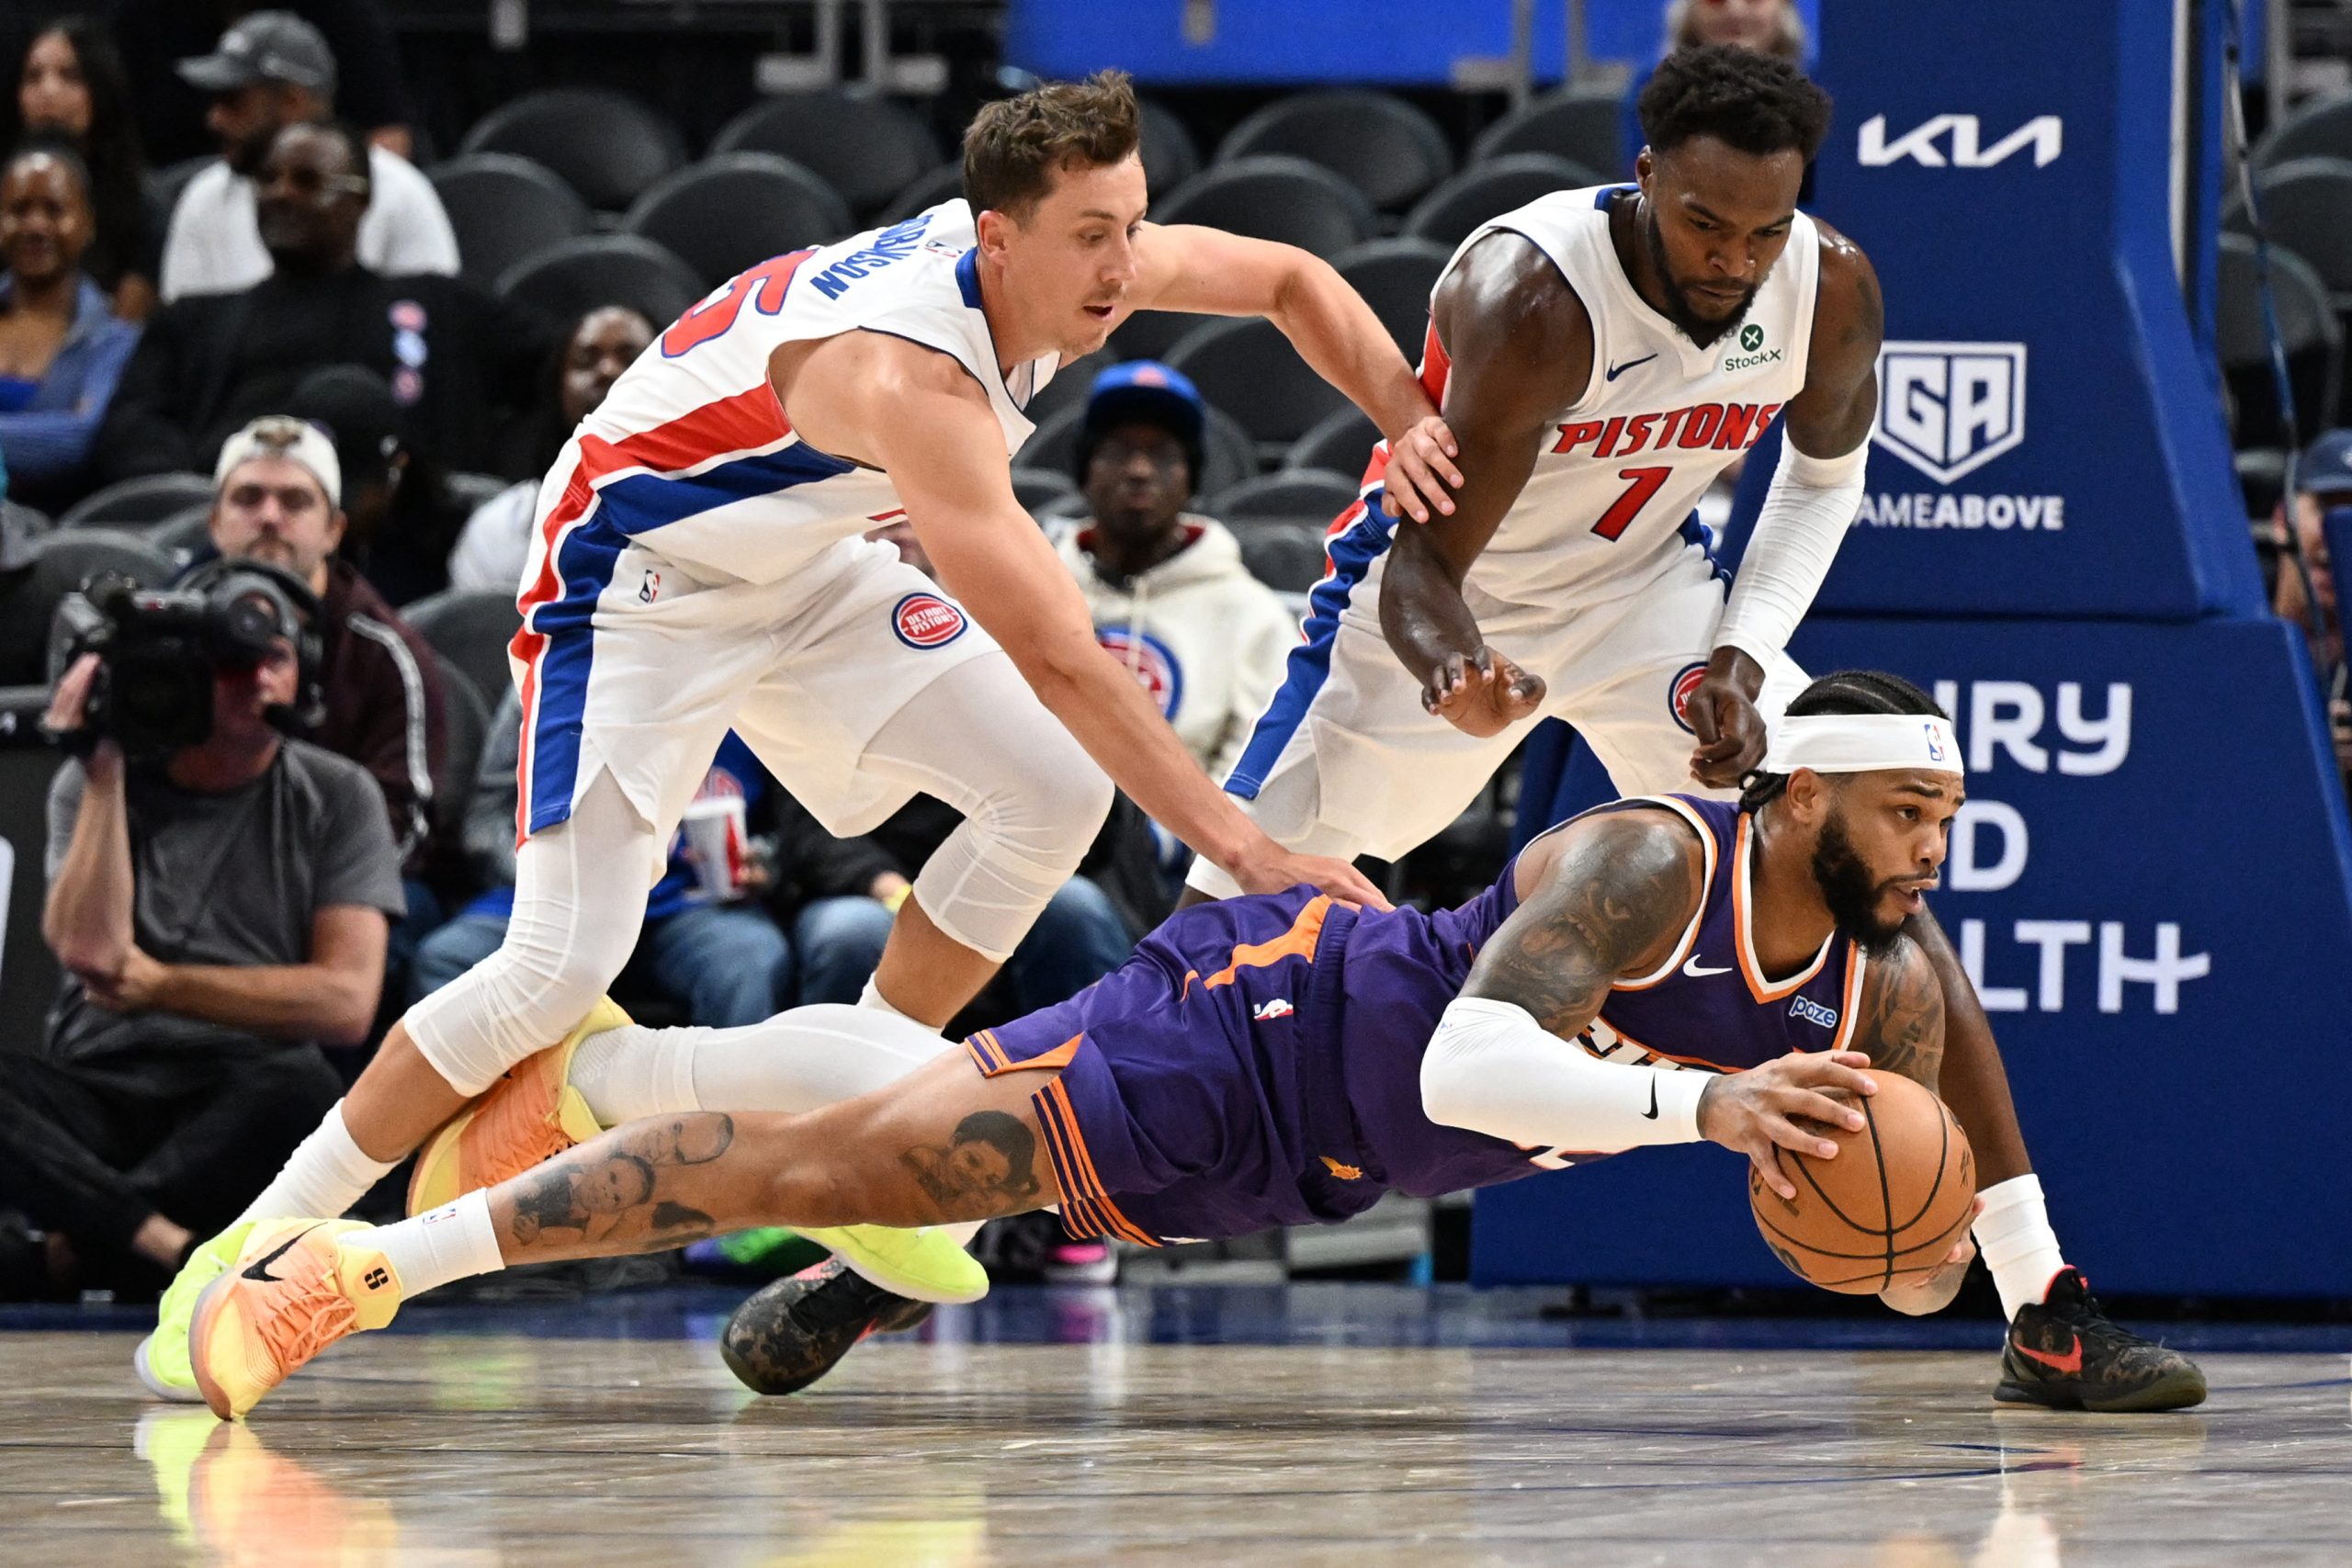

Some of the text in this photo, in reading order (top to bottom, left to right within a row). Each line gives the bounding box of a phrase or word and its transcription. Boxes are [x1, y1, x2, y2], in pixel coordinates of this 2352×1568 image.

[1724, 348, 1782, 372] StockX
[1551, 402, 1782, 459] PISTONS
[1885, 355, 2012, 465] GA
[1590, 466, 1674, 544] 7
[1852, 492, 2064, 532] AMEABOVE
[1934, 680, 2132, 776] RY
[1933, 799, 2030, 892] D
[1961, 919, 2211, 1014] LTH
